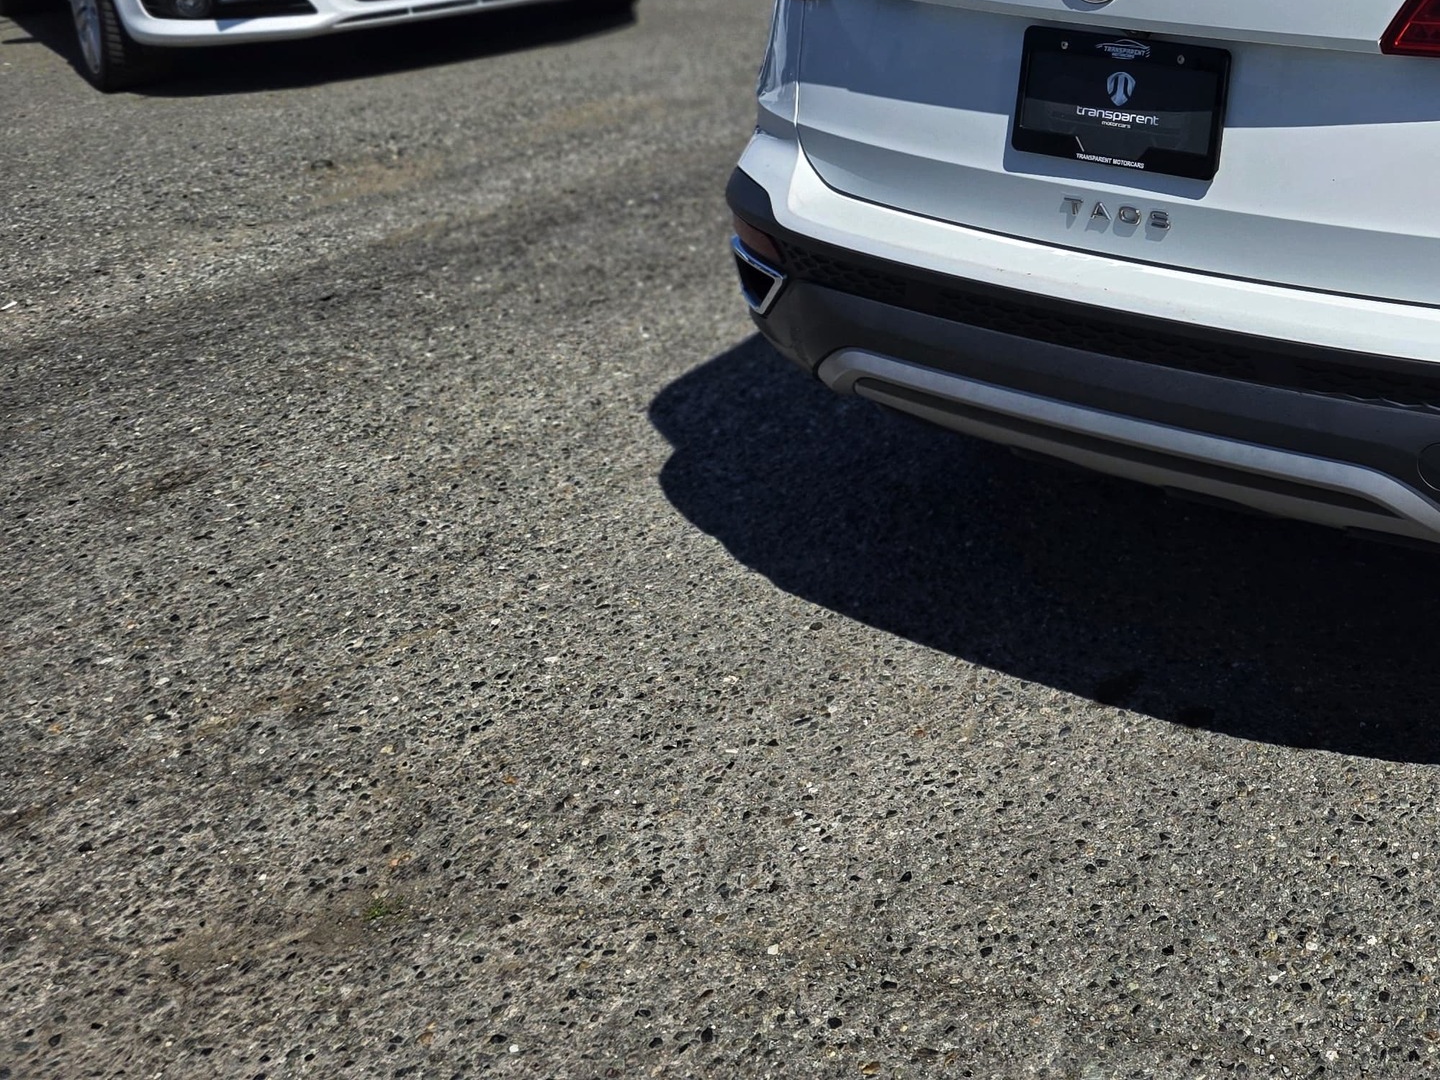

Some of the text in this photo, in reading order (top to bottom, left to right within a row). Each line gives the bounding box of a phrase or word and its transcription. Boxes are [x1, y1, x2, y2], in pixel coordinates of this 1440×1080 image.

[1076, 105, 1159, 126] transparent
[1101, 120, 1131, 129] motorcars
[1076, 152, 1145, 169] TRANSPARENT MOTORCARS
[1063, 197, 1171, 231] TAOS
